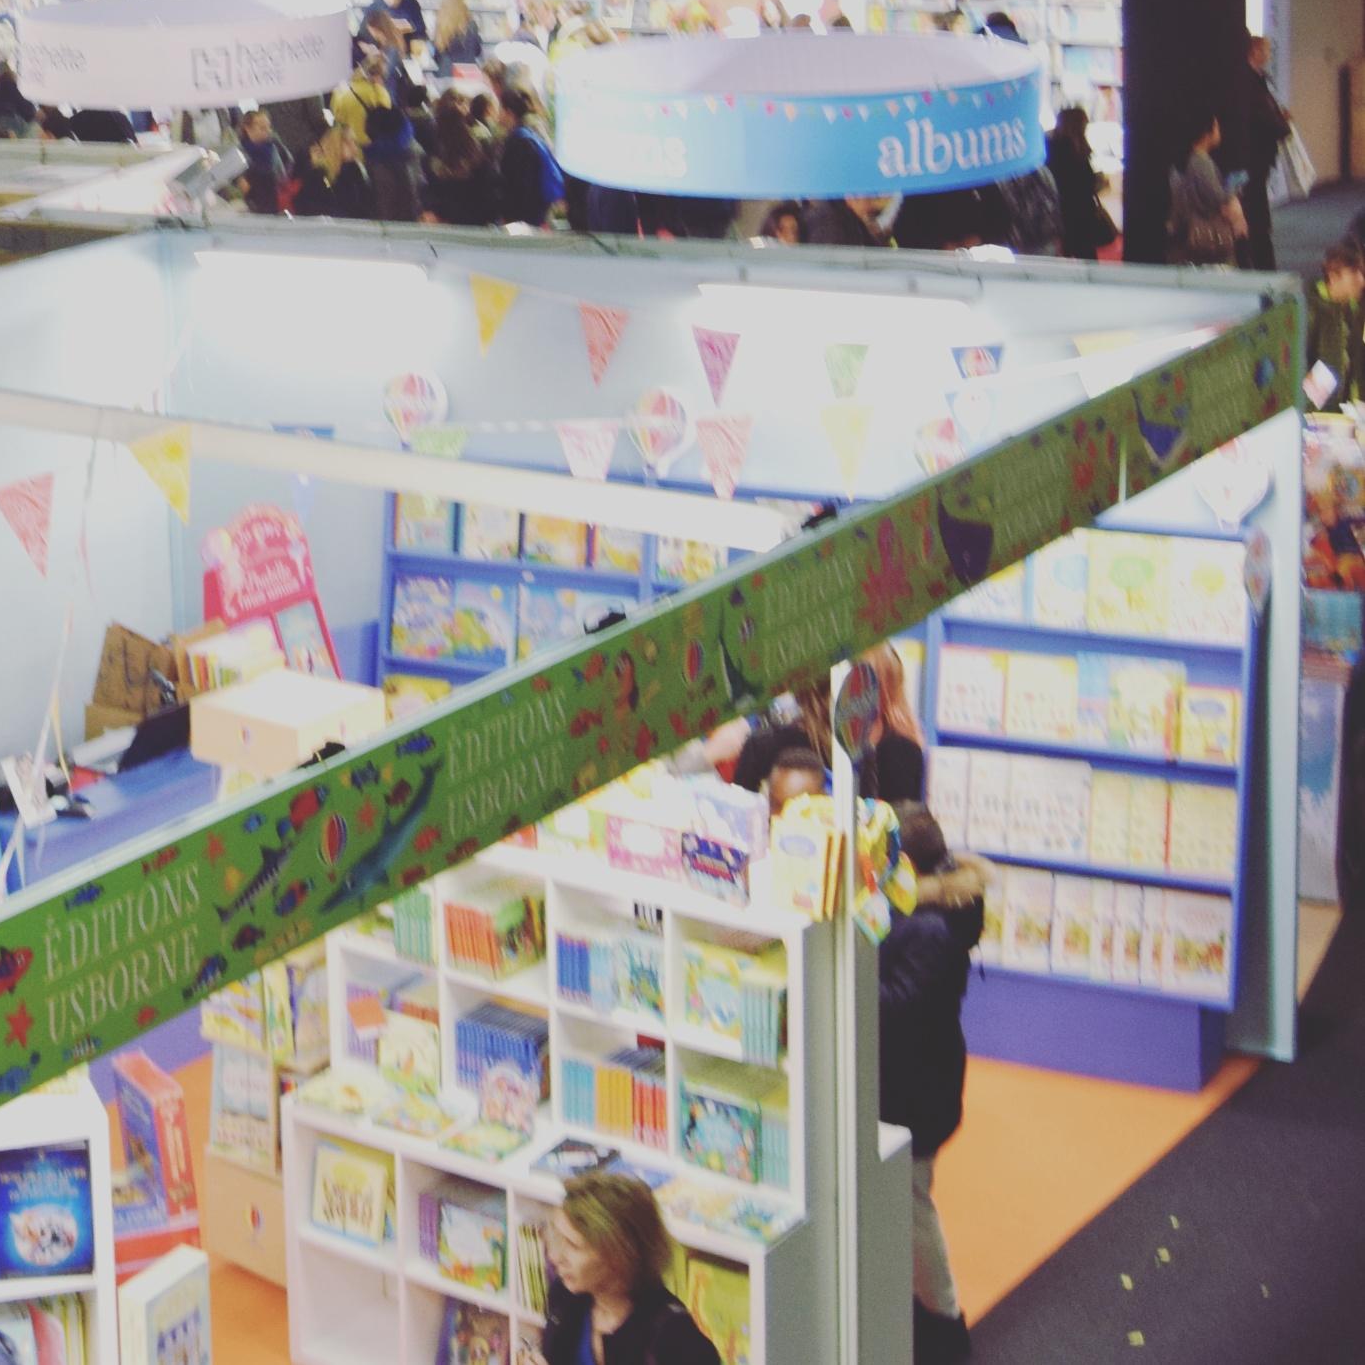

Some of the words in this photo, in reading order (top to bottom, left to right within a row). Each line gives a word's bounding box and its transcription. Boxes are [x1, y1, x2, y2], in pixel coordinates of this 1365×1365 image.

[877, 117, 1028, 179] albums
[45, 862, 201, 984] ÉDITIONS
[45, 923, 199, 1046] USBORNE
